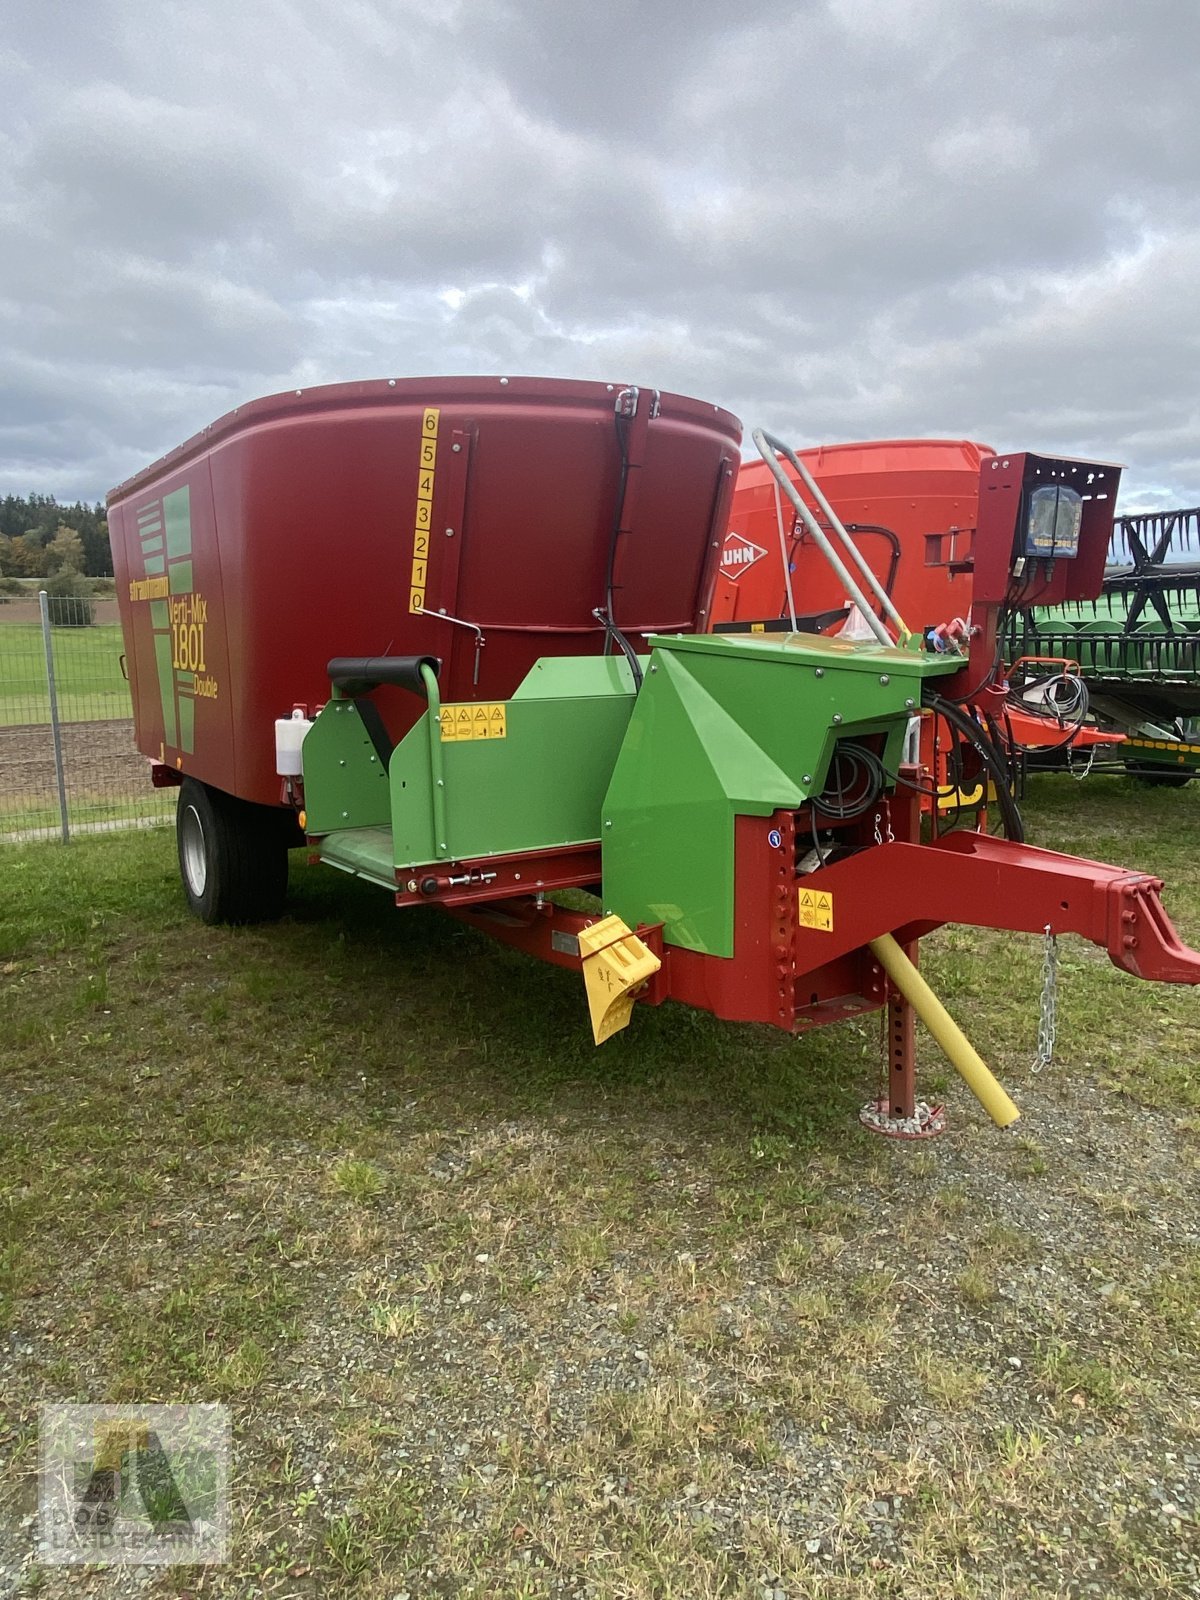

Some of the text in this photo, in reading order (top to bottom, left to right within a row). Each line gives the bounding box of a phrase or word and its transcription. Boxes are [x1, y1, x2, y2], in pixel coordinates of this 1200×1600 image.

[425, 414, 436, 431] 6
[423, 445, 433, 462] 5
[421, 477, 431, 493] 4
[418, 507, 428, 523] 3
[416, 537, 426, 552] 2
[720, 546, 754, 567] UHN
[416, 566, 423, 581] 1
[168, 593, 208, 624] Verti-Mix
[412, 594, 422, 610] 0
[173, 623, 206, 672] 1801
[194, 673, 218, 699] Double
